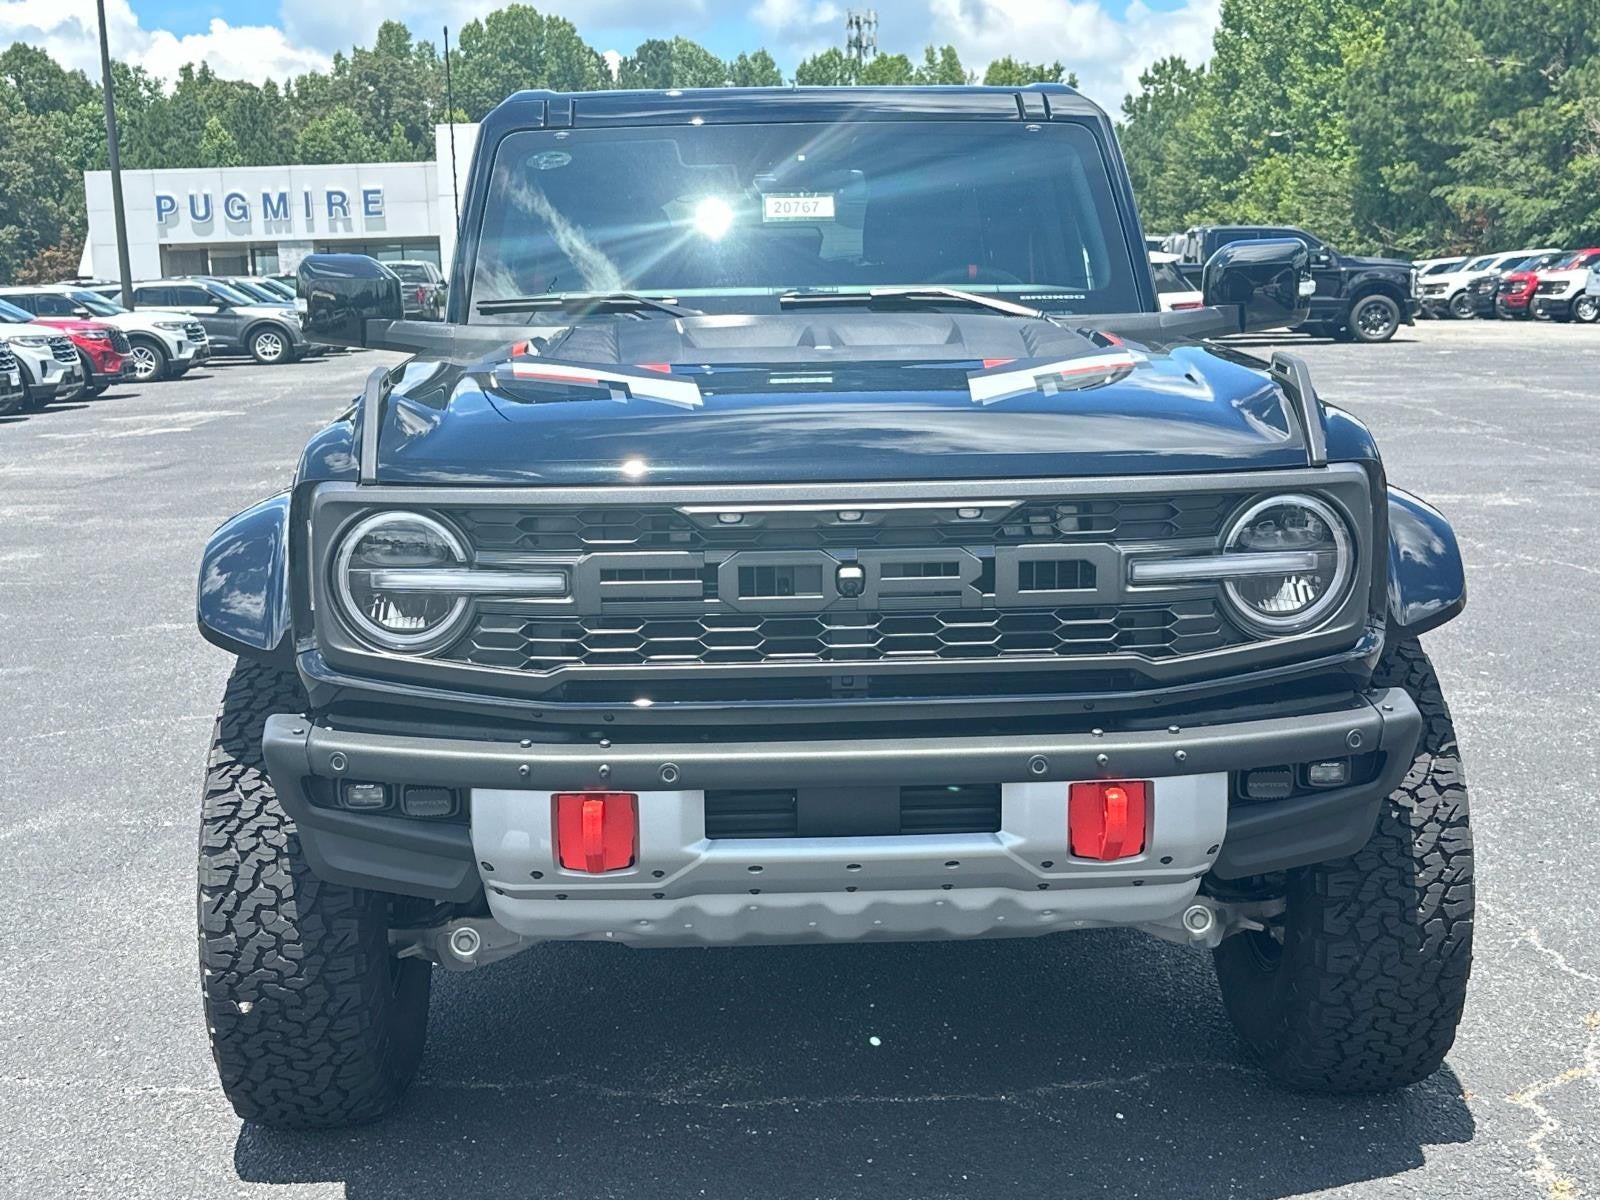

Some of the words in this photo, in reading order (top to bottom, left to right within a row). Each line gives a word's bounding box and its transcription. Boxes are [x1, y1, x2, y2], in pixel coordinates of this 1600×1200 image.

[155, 188, 385, 224] PUGMIRE
[773, 201, 819, 214] 20767
[574, 543, 1121, 613] FORD
